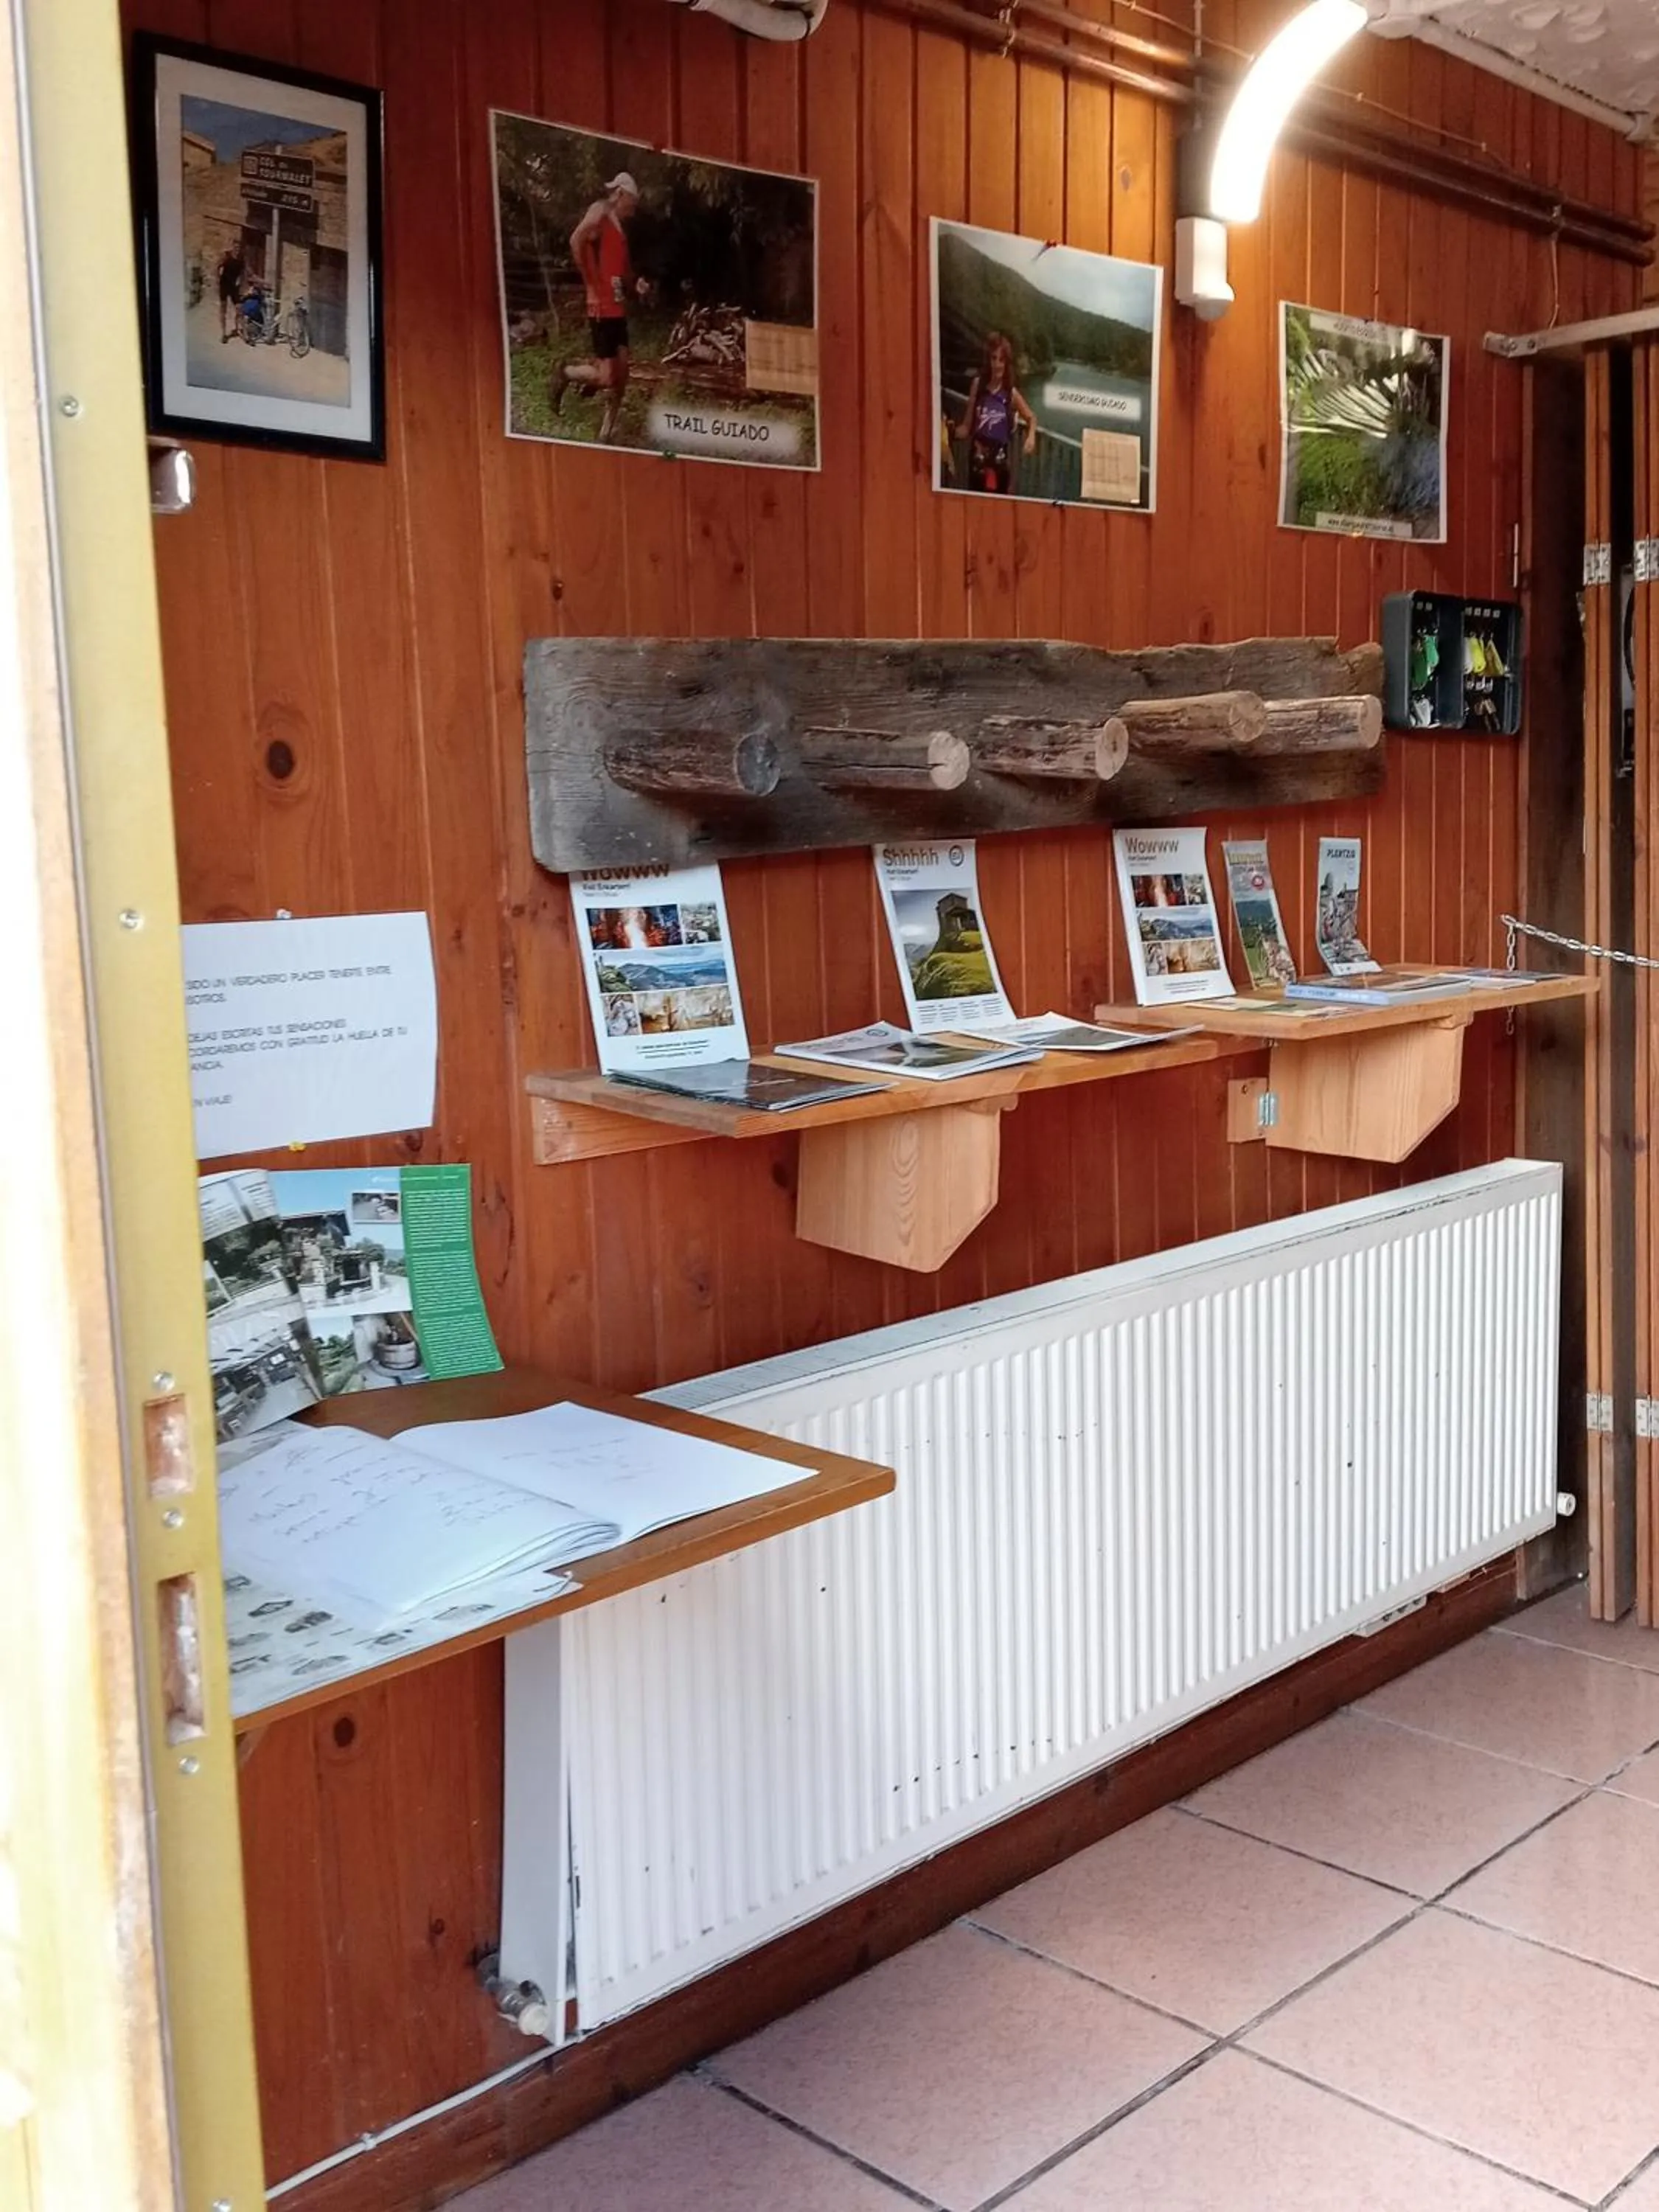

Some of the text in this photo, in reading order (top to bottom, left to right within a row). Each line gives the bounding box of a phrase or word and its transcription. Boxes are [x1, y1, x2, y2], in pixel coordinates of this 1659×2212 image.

[664, 413, 770, 442] TRAIL GUIADO
[1125, 837, 1179, 854] Wowww
